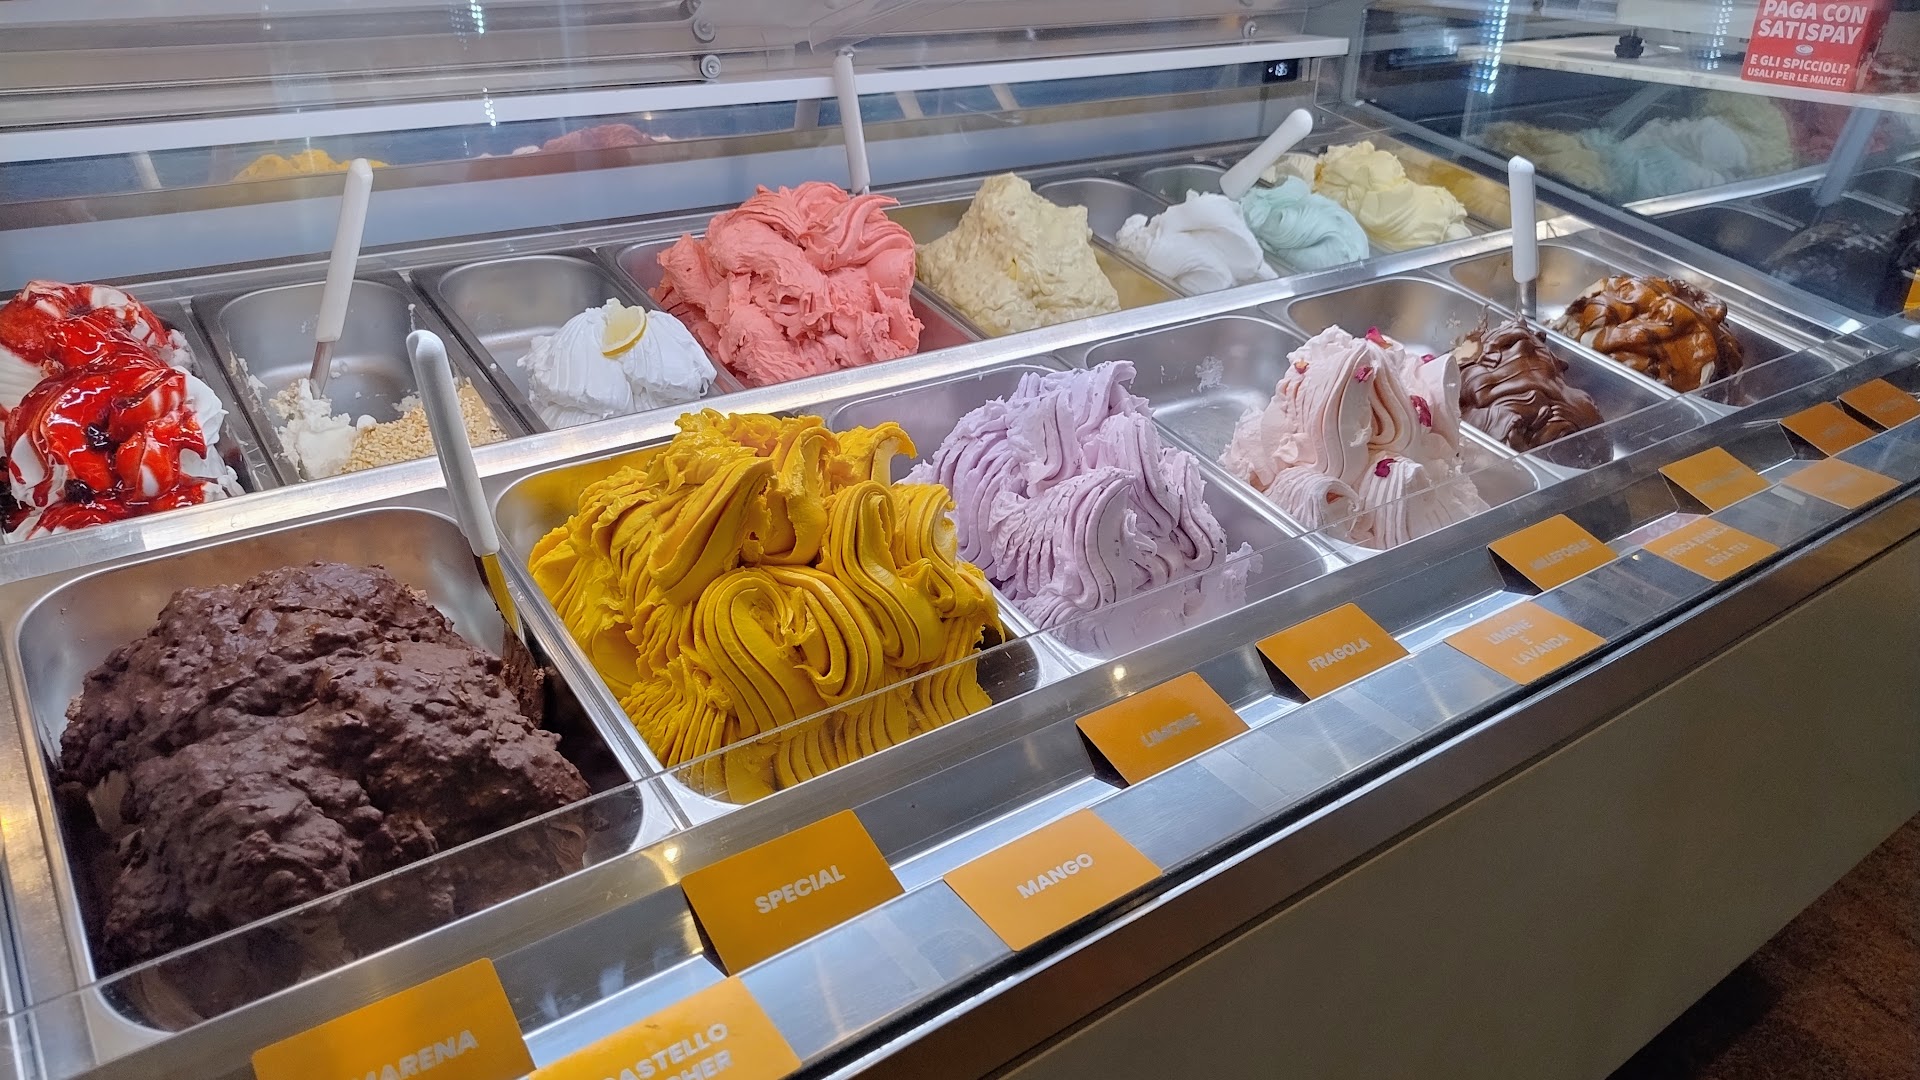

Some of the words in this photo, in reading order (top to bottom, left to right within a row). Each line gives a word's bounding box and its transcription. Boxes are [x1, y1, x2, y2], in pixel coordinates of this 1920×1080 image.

[1763, 0, 1817, 20] PAGA
[1823, 4, 1867, 24] CON
[1758, 19, 1862, 45] SATISPAY
[1747, 67, 1774, 78] USALI
[1776, 71, 1796, 81] PER
[1797, 73, 1808, 83] LE
[1809, 75, 1847, 87] MANCE!
[1750, 54, 1759, 65] E
[1760, 55, 1780, 67] GLI
[1782, 58, 1850, 75] SPICCIOLI?
[1487, 619, 1533, 646] LIMONE
[1519, 636, 1533, 646] E
[1307, 637, 1372, 672] FRAGOLA
[1511, 633, 1572, 665] LAVANDA
[754, 865, 846, 914] SPECIAL
[1016, 853, 1094, 899] MANGO
[602, 1023, 728, 1080] ASTELLO
